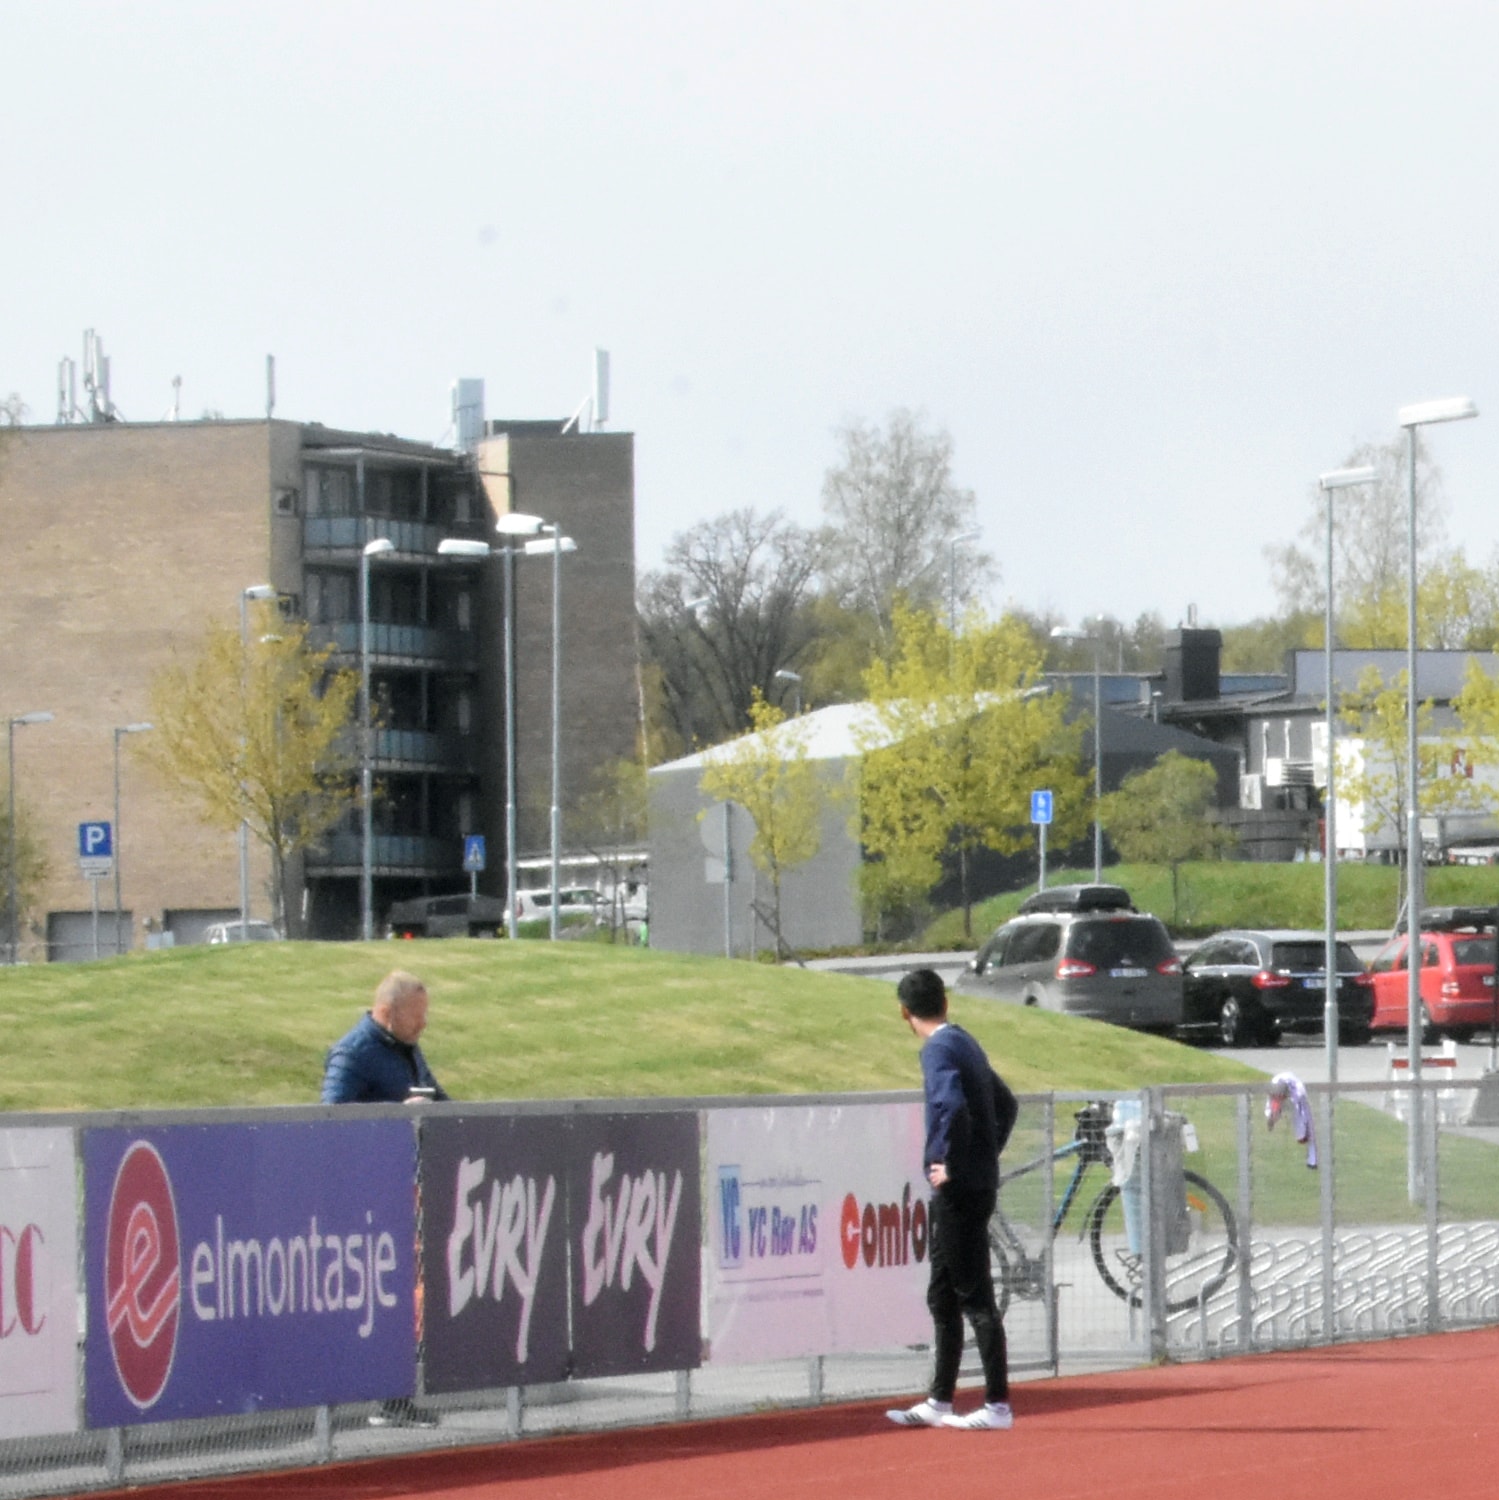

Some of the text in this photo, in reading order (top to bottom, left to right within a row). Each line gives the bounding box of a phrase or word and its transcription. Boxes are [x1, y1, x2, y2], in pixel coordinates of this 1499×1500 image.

[86, 826, 105, 853] P
[748, 1206, 767, 1258] YC
[798, 1203, 818, 1255] AS
[840, 1183, 935, 1270] Comfo
[191, 1210, 397, 1338] elmontasje
